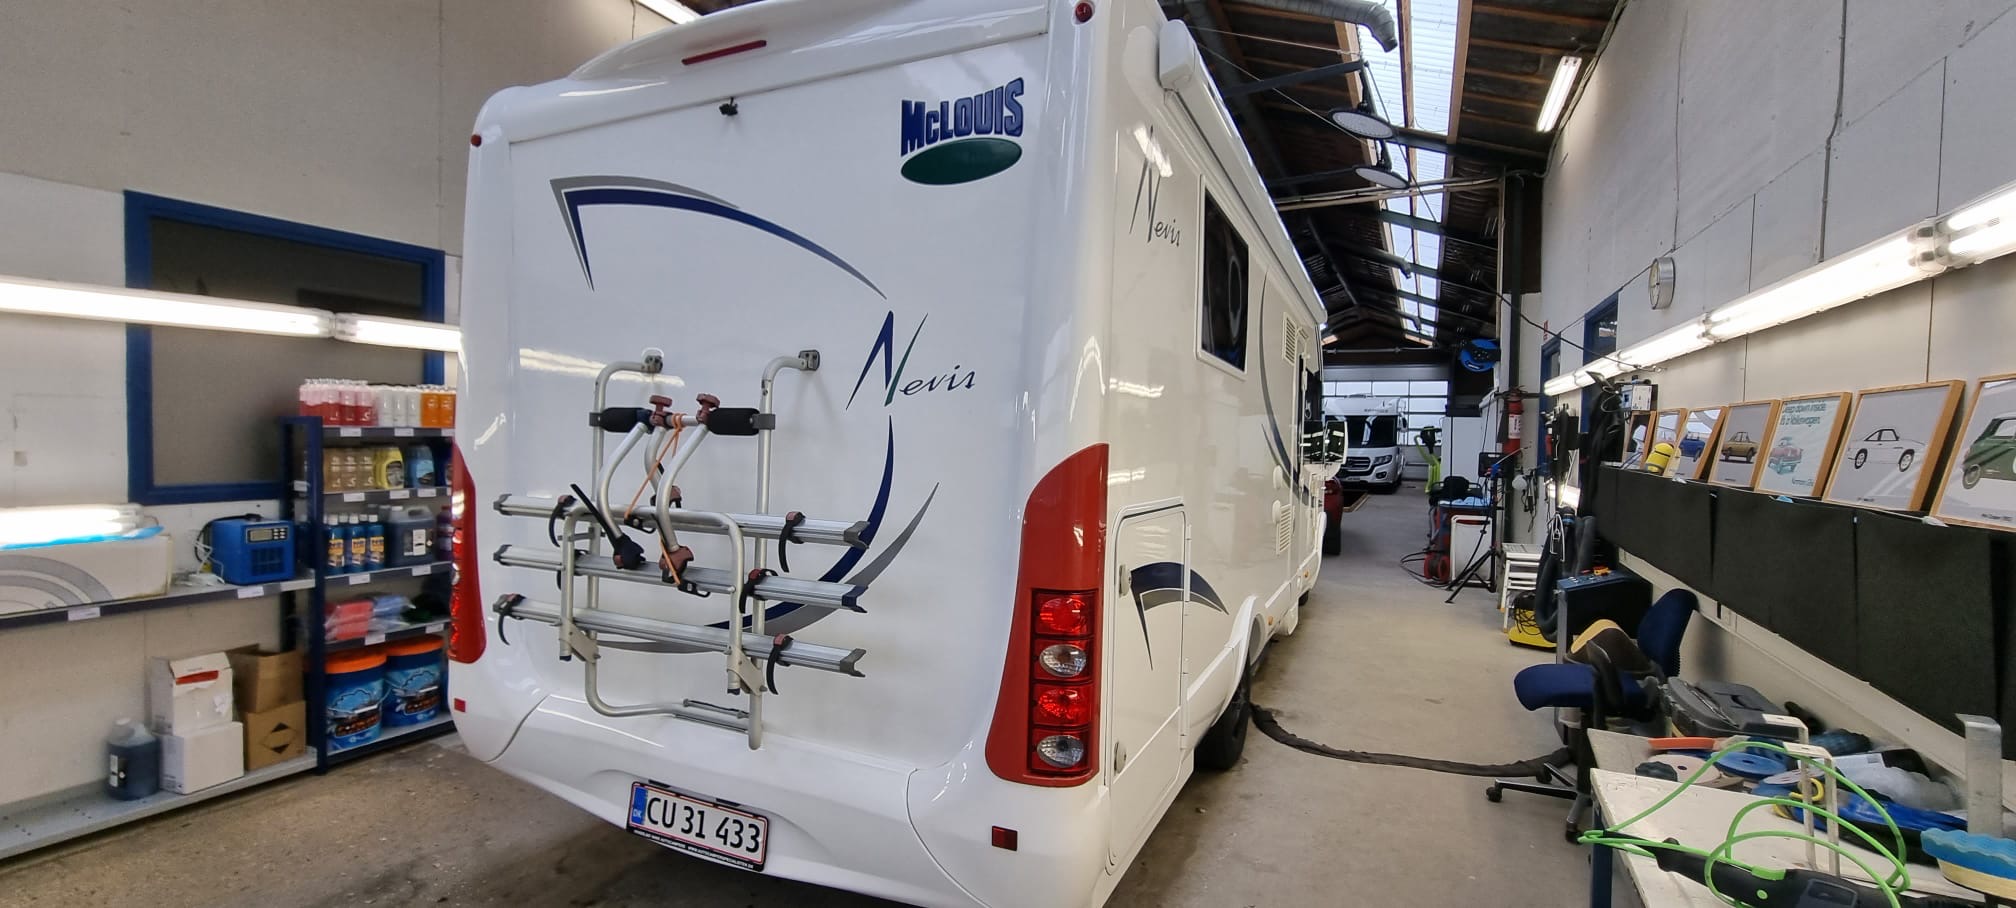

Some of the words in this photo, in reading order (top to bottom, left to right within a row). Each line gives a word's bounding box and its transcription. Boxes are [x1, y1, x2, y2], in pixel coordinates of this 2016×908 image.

[901, 77, 1024, 157] McLOUIS
[845, 310, 976, 411] Nevis
[647, 797, 677, 828] CU
[681, 805, 706, 839] 31
[715, 816, 760, 853] 433
